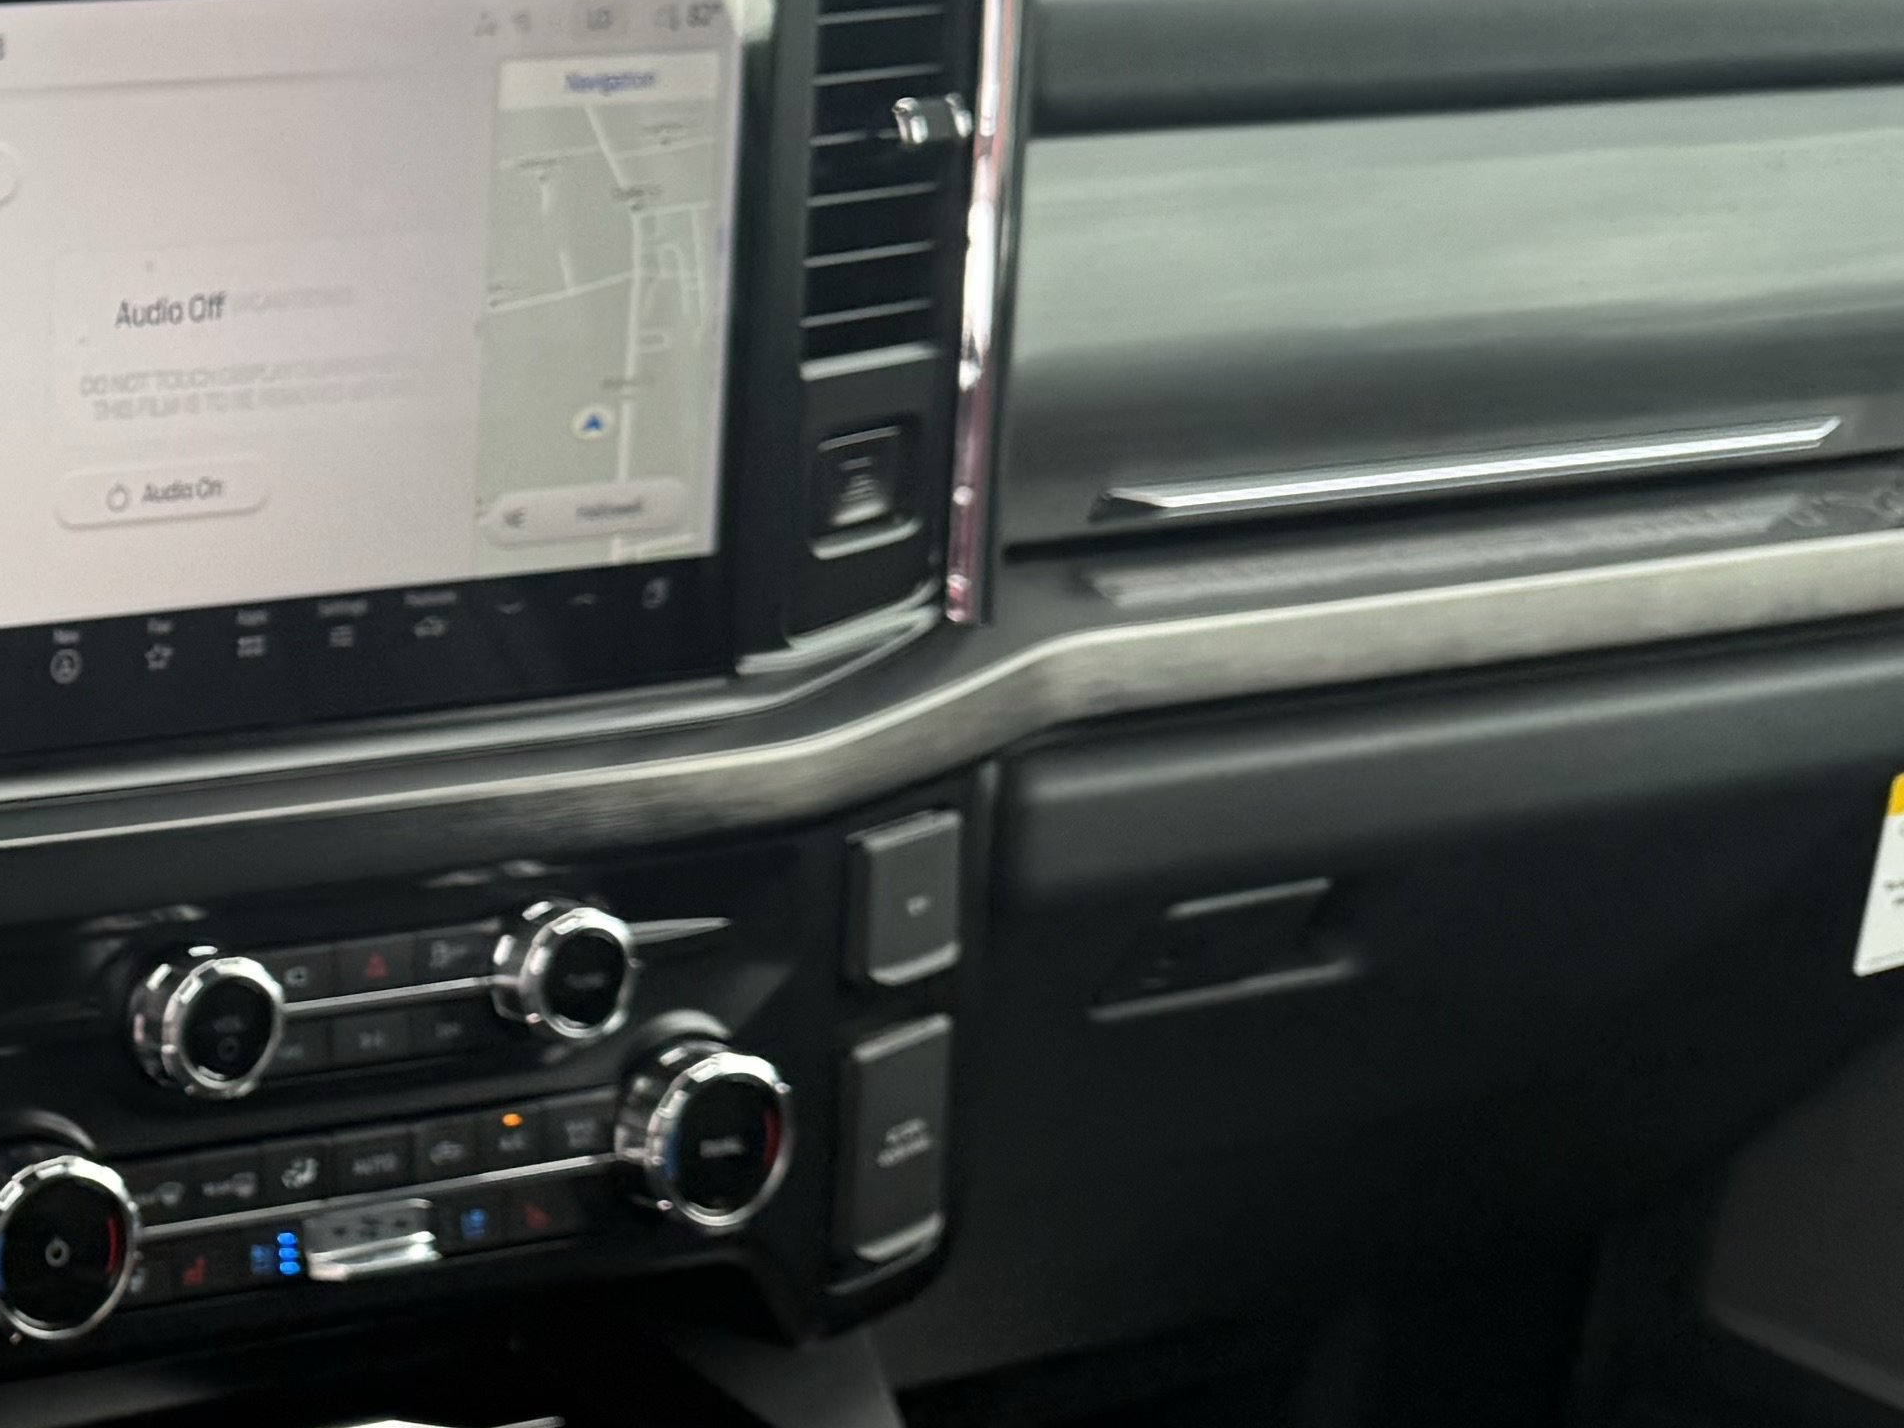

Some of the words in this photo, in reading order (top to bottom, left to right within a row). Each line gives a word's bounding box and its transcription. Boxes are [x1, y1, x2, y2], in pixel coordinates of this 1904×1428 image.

[114, 295, 184, 329] Audio
[188, 290, 227, 322] Off
[141, 480, 193, 503] Audio
[195, 477, 224, 498] On
